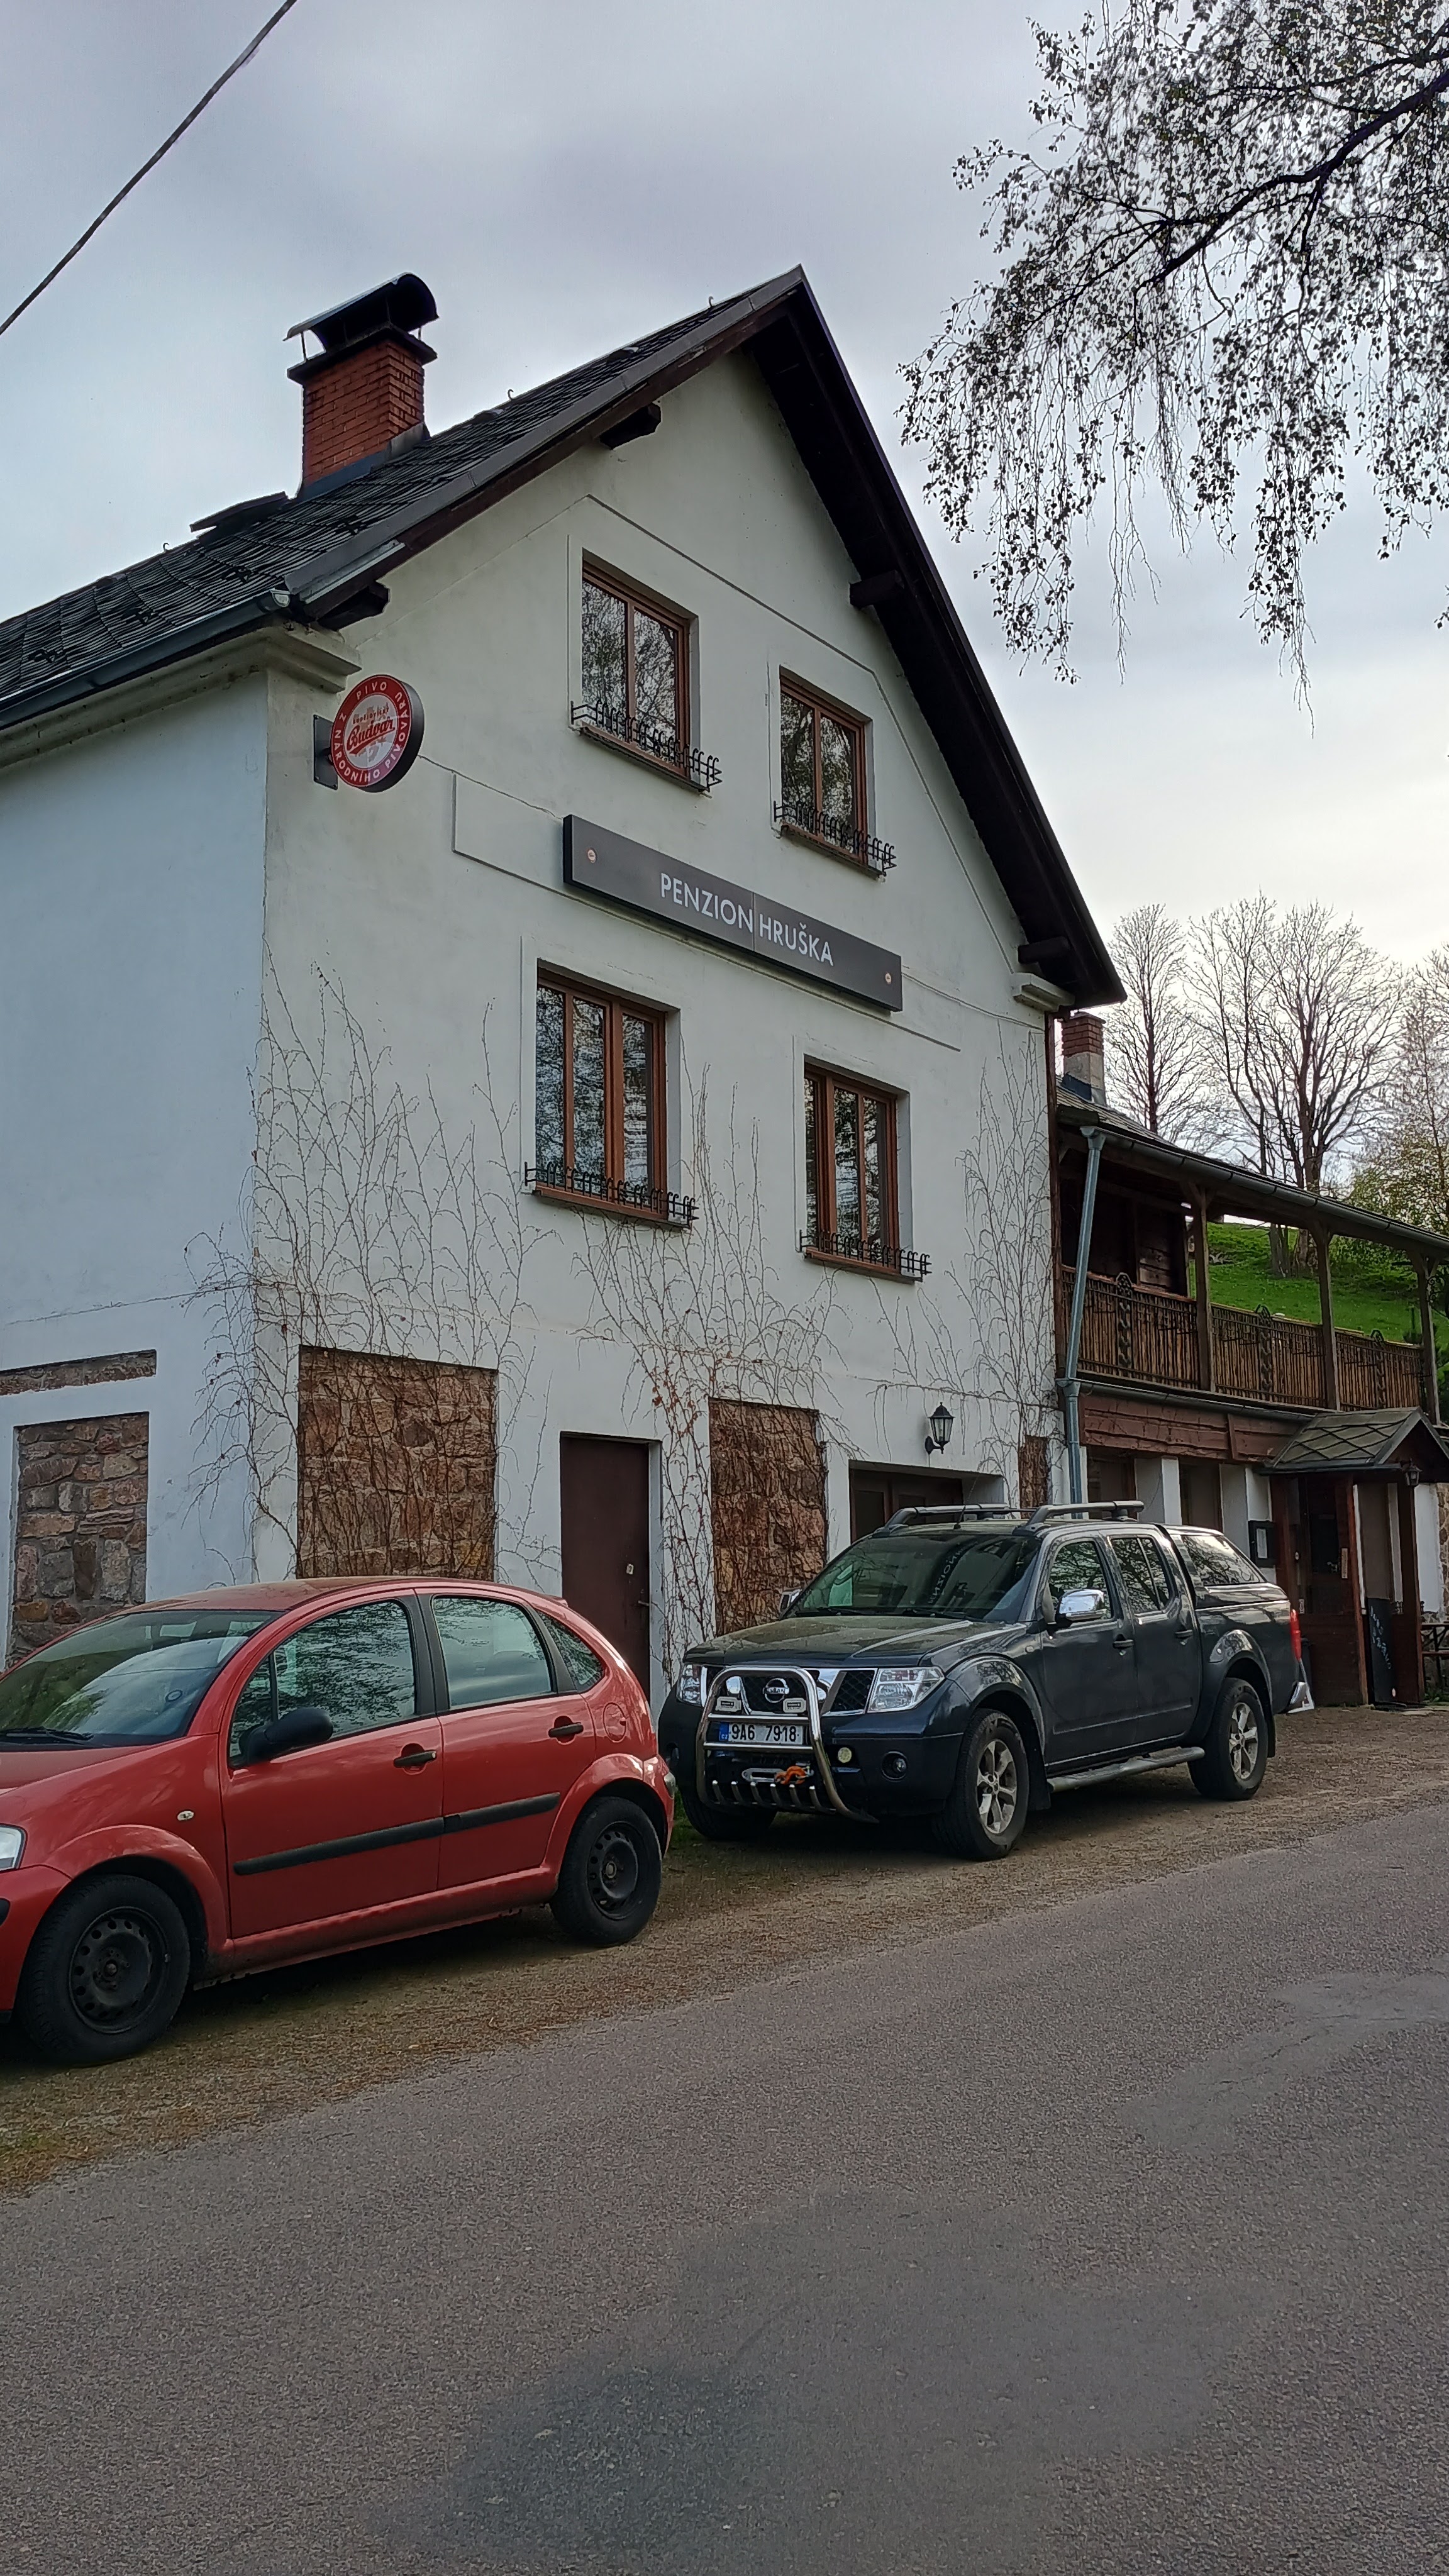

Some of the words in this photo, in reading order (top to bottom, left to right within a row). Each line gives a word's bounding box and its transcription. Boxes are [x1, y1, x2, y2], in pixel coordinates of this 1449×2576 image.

[356, 681, 387, 701] PIVO
[338, 713, 347, 722] Z
[384, 692, 411, 769] PIVOVARU
[347, 716, 396, 751] Budvar
[660, 872, 753, 933] PENZION
[759, 913, 834, 967] HRUŠKA
[731, 1724, 755, 1740] 9A6
[765, 1725, 796, 1742] 7918
